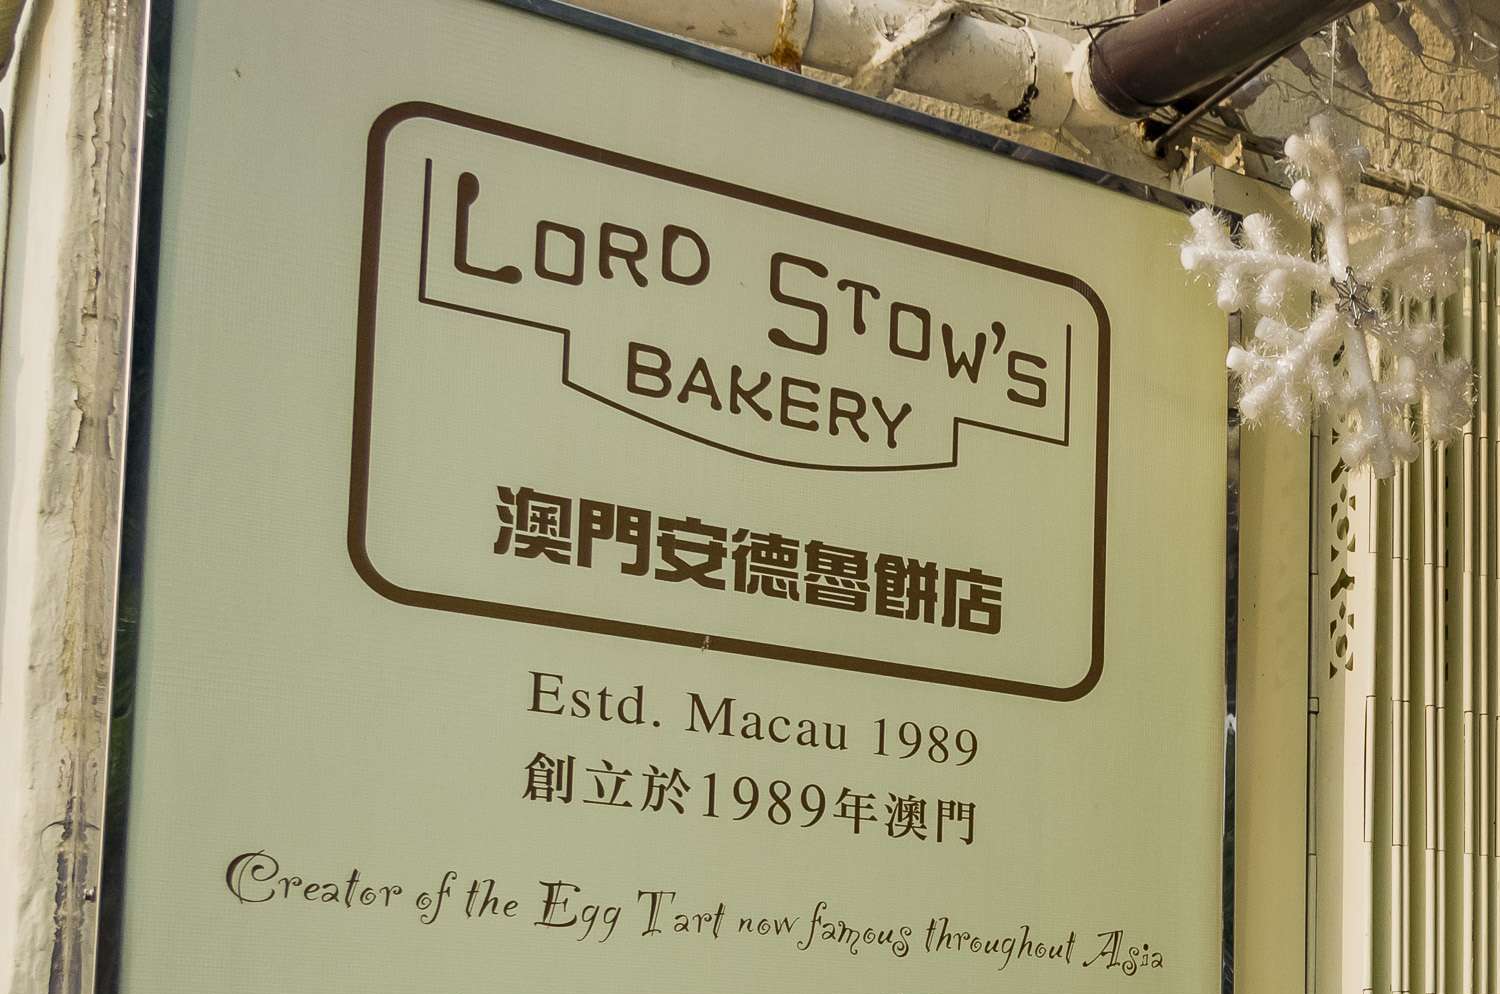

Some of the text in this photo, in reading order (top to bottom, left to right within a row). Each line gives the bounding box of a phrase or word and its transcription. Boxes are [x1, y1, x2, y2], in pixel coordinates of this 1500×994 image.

[454, 171, 1048, 408] LORD STOW'S
[625, 341, 913, 449] BAKERY
[493, 484, 1003, 635] 澳門安德魯餅店
[526, 670, 979, 767] Estd. Macau 1989
[521, 750, 977, 846] 創立於1989年澳門
[225, 849, 1165, 977] Creator of the Egg Tart now famous throughout Asia
